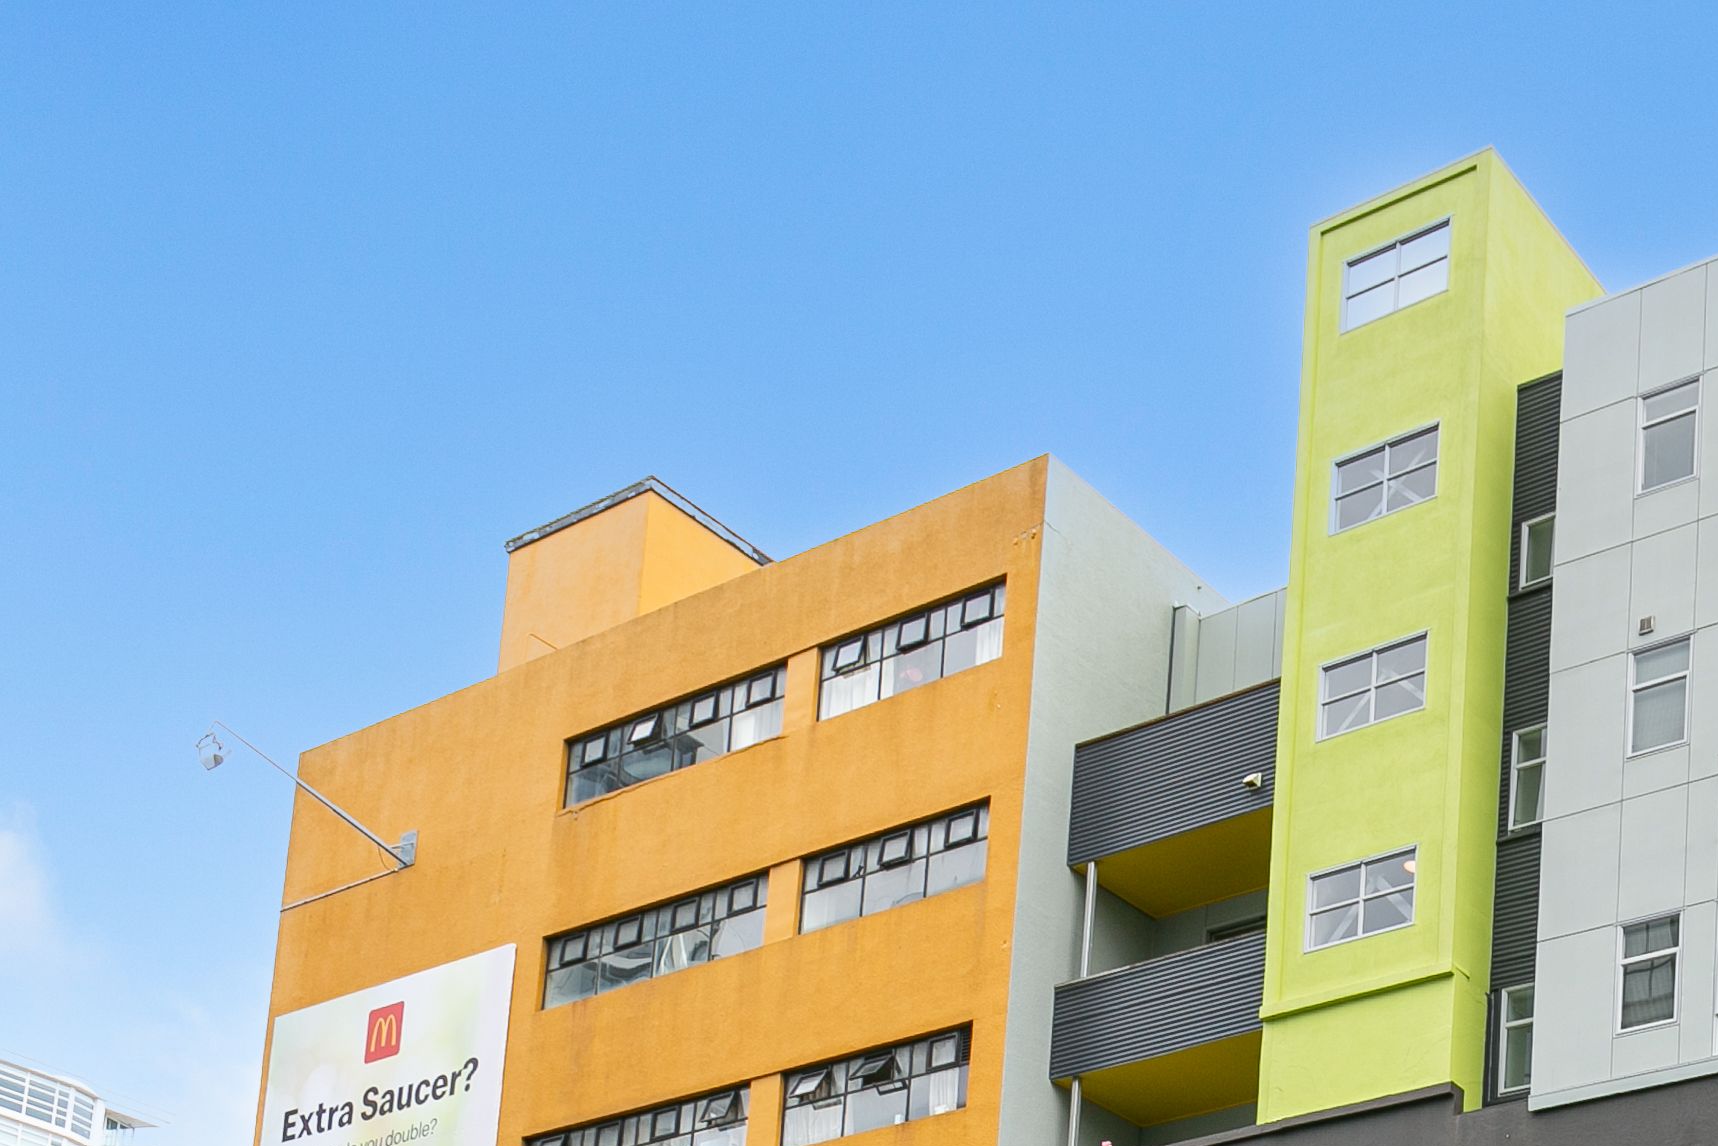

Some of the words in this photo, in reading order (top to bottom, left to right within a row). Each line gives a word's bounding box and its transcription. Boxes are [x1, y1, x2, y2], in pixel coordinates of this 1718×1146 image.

[281, 1101, 354, 1143] Extra
[360, 1057, 479, 1121] Saucer?
[385, 1118, 438, 1146] double?
